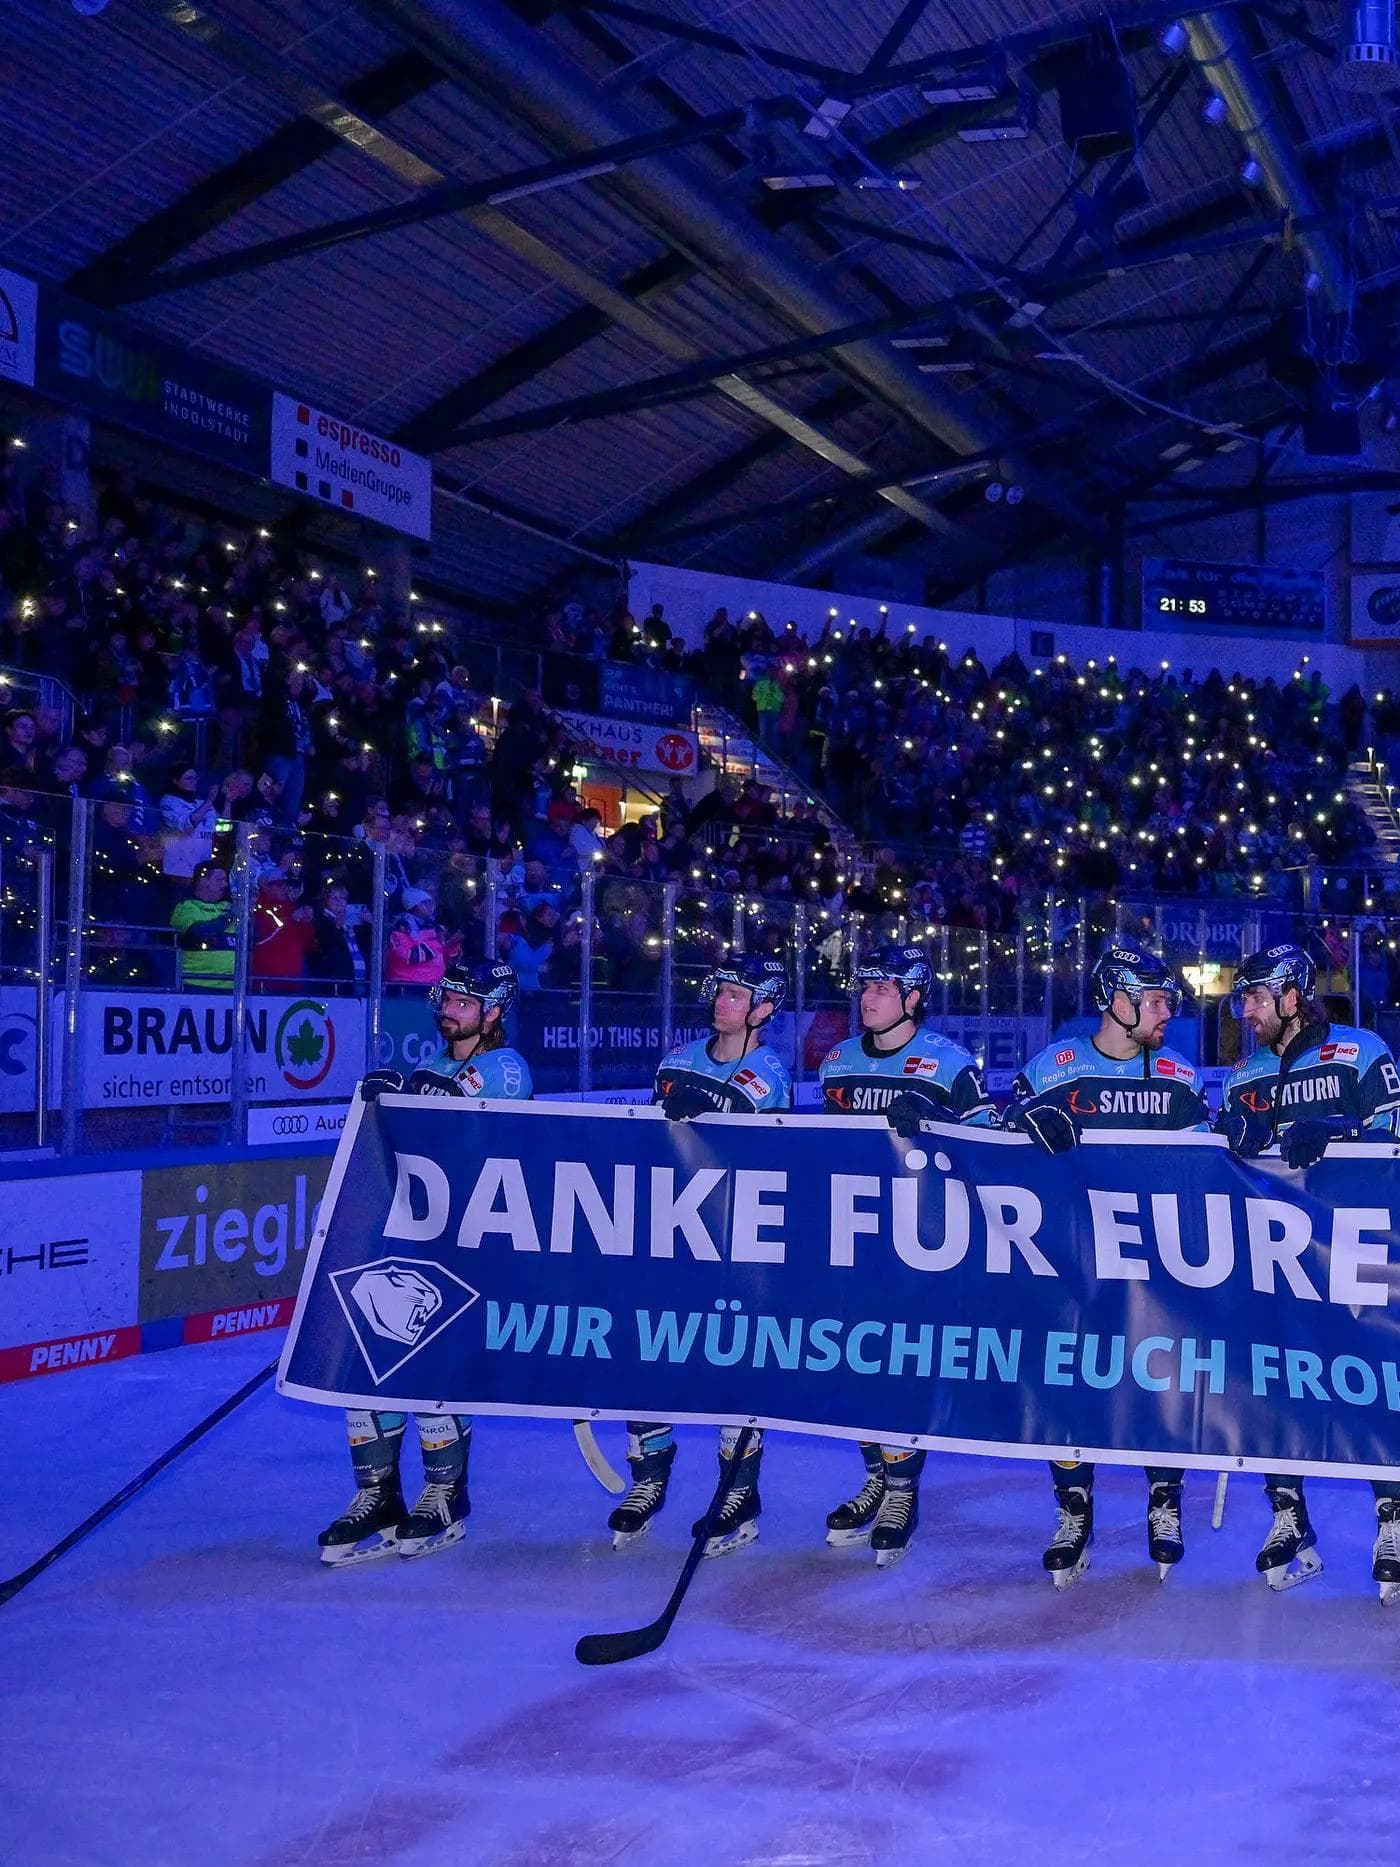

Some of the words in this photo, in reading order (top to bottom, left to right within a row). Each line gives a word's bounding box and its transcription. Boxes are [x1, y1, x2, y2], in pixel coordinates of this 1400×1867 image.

[164, 380, 249, 426] STADTWERKE
[164, 401, 249, 445] INGOLSTADT
[317, 412, 402, 468] espresso
[315, 447, 412, 506] MedienGruppe
[1160, 597, 1207, 614] 21:53
[103, 1007, 267, 1055] BRAUN
[608, 1027, 641, 1048] THIS
[647, 1027, 659, 1048] IS
[1058, 1051, 1073, 1063] DB
[103, 1078, 163, 1098] sicher
[170, 1075, 266, 1097] entsoren
[852, 1088, 902, 1110] SATU
[1270, 1075, 1340, 1108] SATURN
[315, 1116, 348, 1131] Aud
[155, 1174, 318, 1276] ziegl
[382, 1150, 787, 1264] DANKE
[829, 1149, 1059, 1278] FÜR
[2, 1238, 89, 1275] HE
[211, 1303, 281, 1337] PENNY
[29, 1333, 118, 1372] PENNY
[485, 1301, 614, 1359] WIR
[637, 1299, 1022, 1383] WÜNSCHEN
[1043, 1331, 1226, 1394] EUCH
